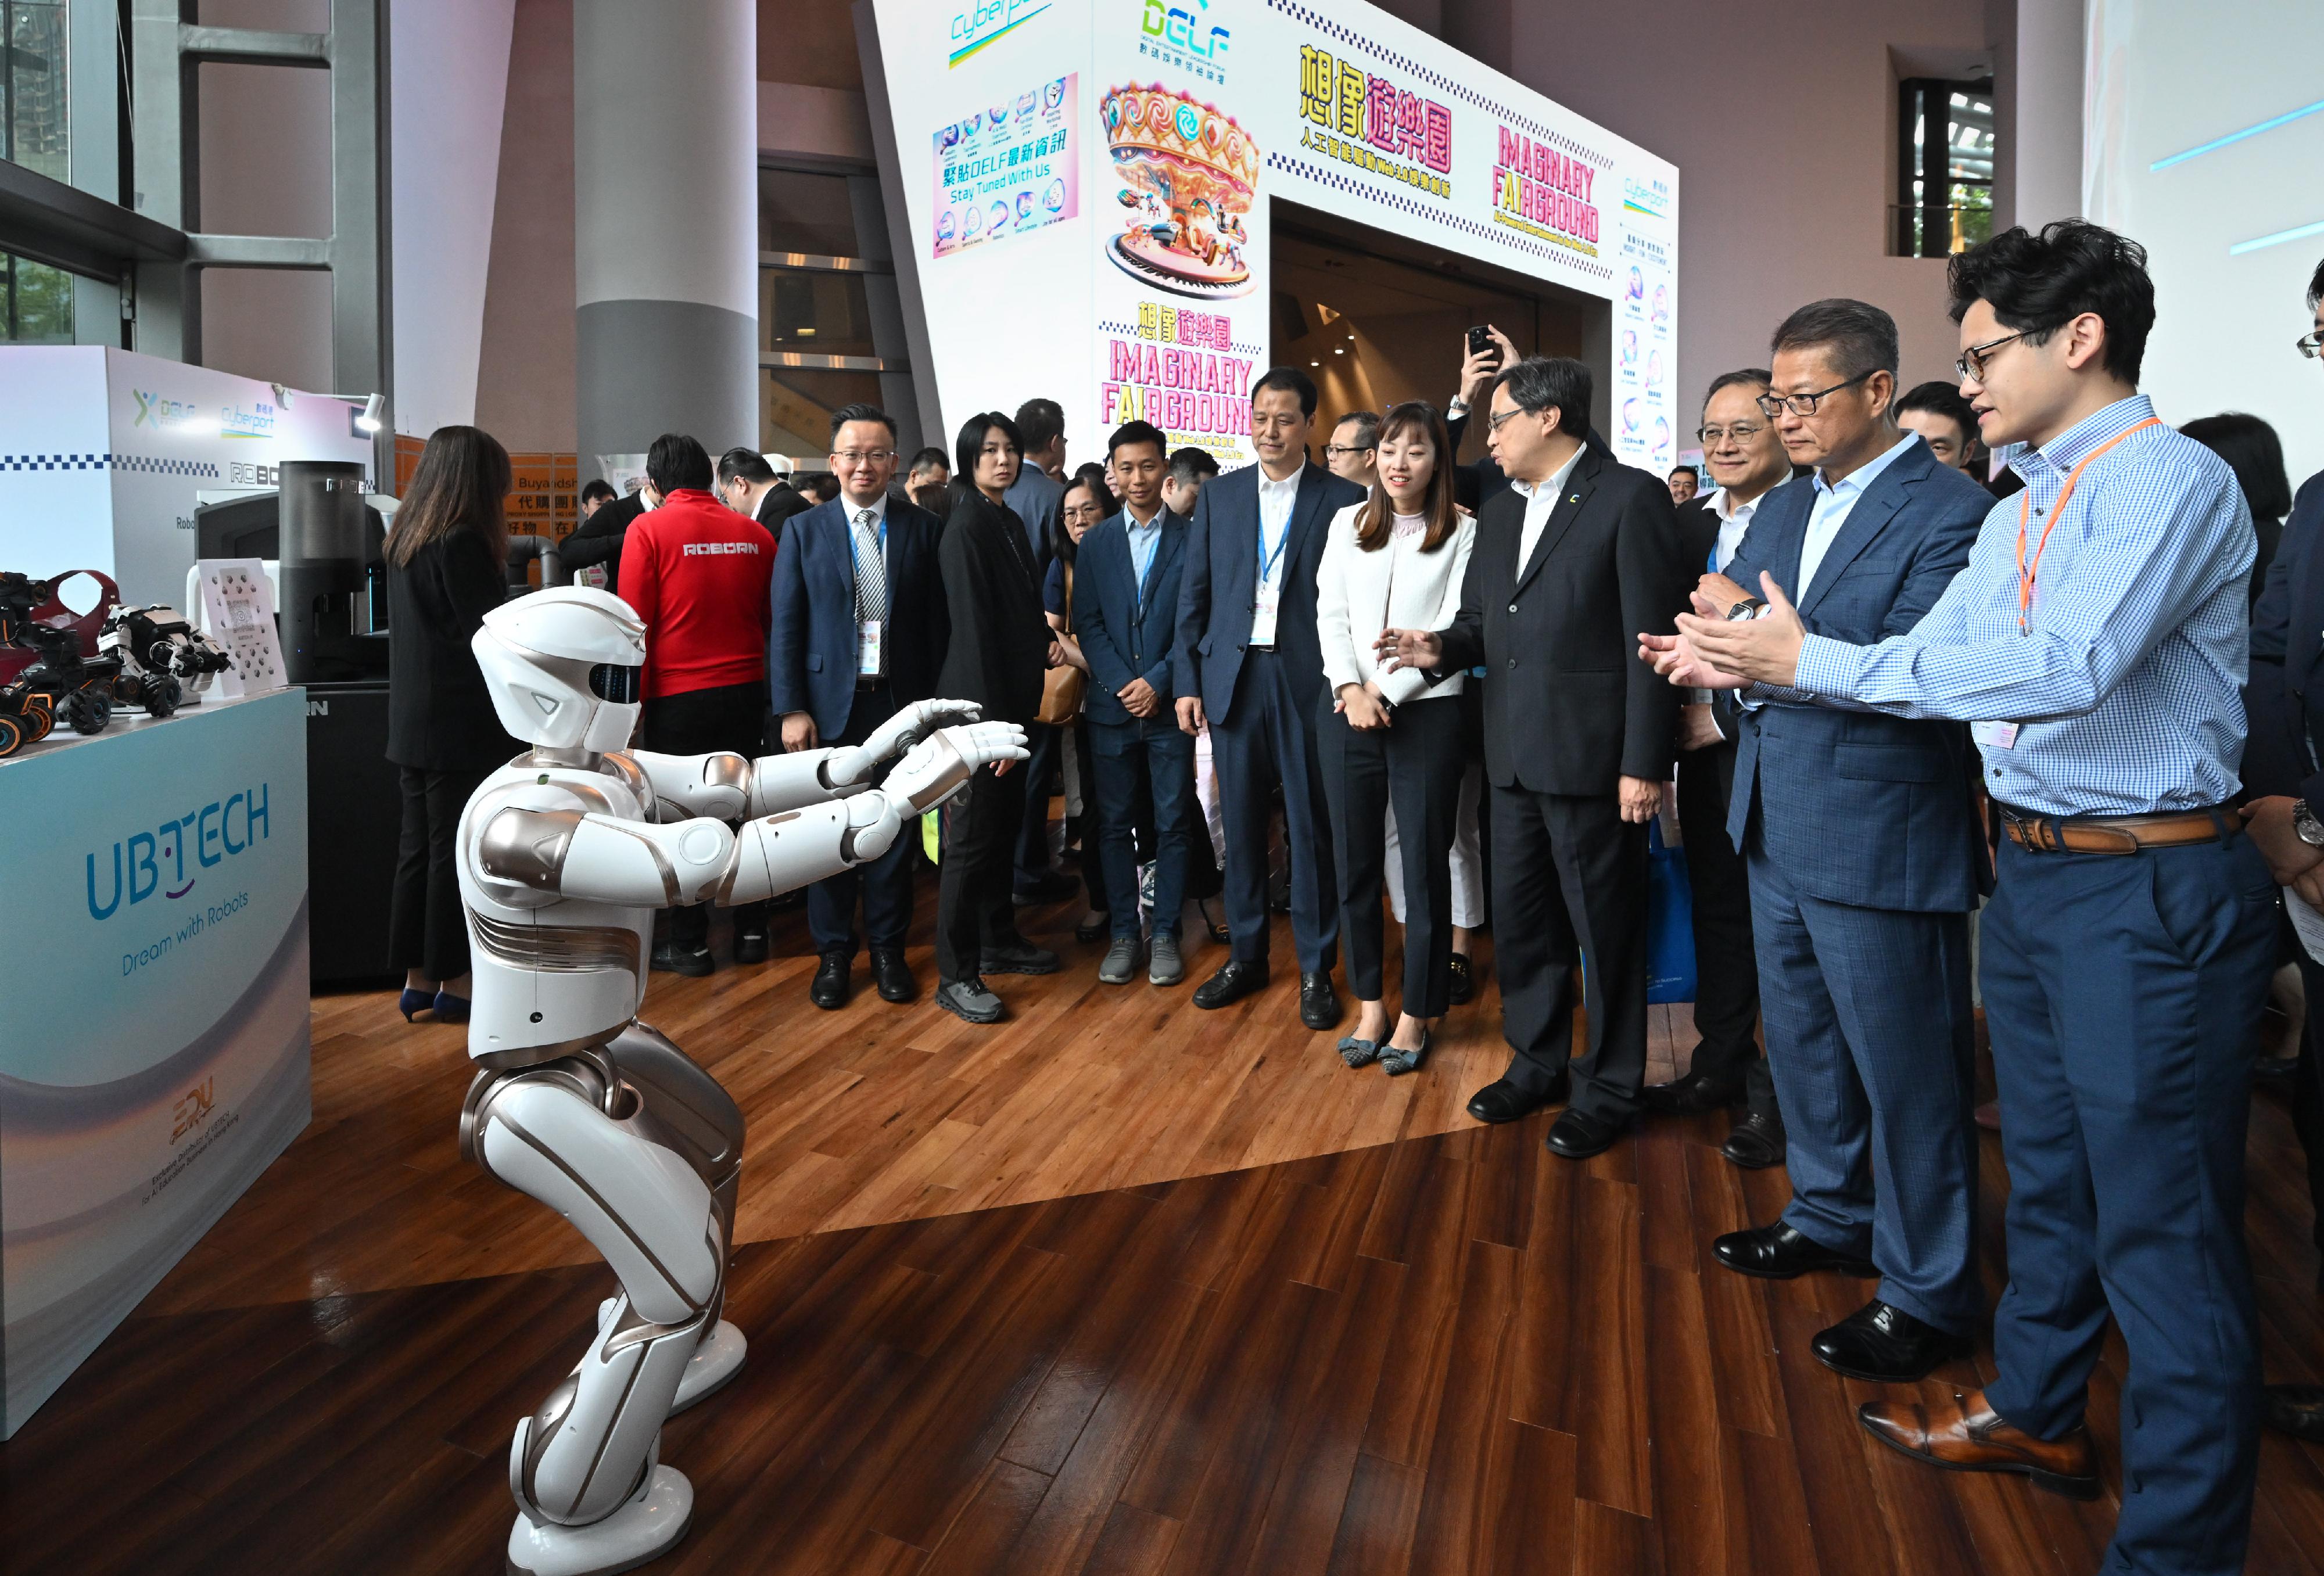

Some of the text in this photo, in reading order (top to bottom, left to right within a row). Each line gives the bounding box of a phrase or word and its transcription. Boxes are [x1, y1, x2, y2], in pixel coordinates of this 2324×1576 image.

[1142, 0, 1230, 59] DELF
[1300, 44, 1451, 175] 想像遊樂園
[951, 163, 1050, 204] Stay Tuned With Us
[1498, 124, 1595, 203] IMAGINARY
[1493, 164, 1598, 243] FAIRGROUND
[1138, 301, 1231, 352] 想像遊樂園
[1110, 339, 1253, 397] IMAGINARY
[221, 404, 275, 435] Cyberport
[683, 542, 759, 557] ROBORN
[306, 701, 328, 716] N
[87, 782, 269, 920] UBTECH
[123, 891, 249, 977] Dream with Robots
[152, 1159, 177, 1185] Exclusive
[178, 1136, 204, 1162] Distributor
[205, 1128, 211, 1138] of
[211, 1110, 230, 1132] UBTECH
[159, 1162, 185, 1190] Education
[187, 1144, 207, 1166] Business
[213, 1126, 227, 1141] Hong
